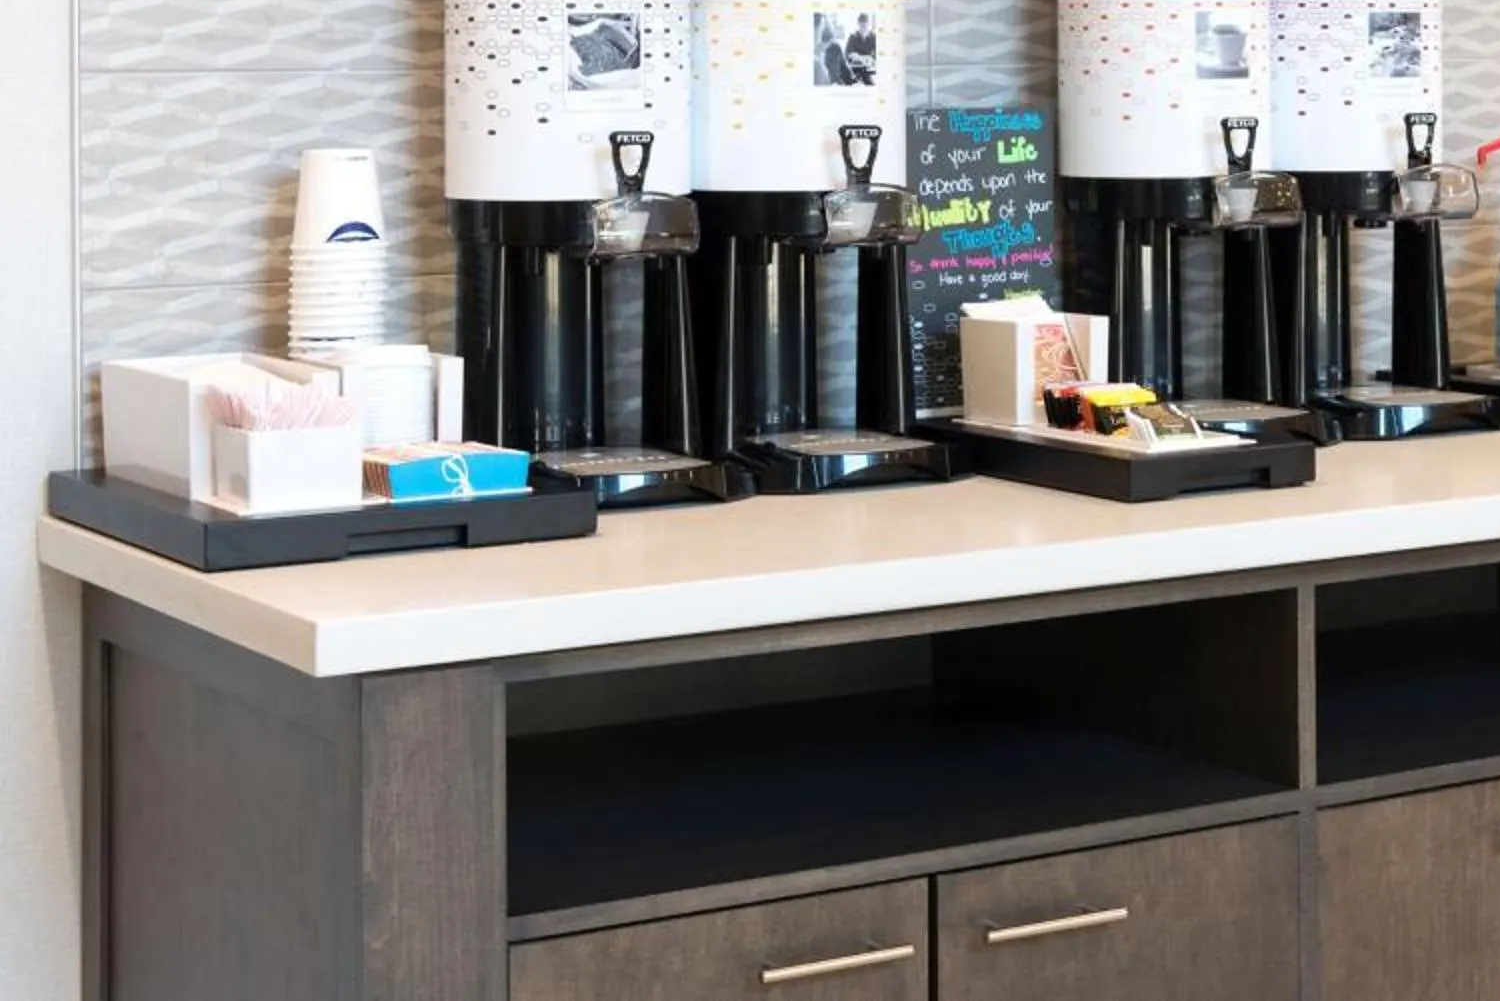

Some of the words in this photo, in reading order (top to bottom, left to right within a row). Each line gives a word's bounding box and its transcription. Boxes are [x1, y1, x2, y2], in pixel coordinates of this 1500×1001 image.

[912, 111, 941, 132] The
[616, 134, 651, 143] FETCO
[844, 128, 879, 137] FETCO
[920, 143, 936, 164] of
[947, 146, 987, 170] your
[997, 135, 1039, 164] Life
[919, 172, 974, 199] depends
[982, 173, 1018, 196] upon
[1023, 169, 1047, 185] the
[999, 199, 1016, 219] of
[1025, 199, 1053, 220] your
[939, 270, 964, 287] Have
[981, 270, 1007, 288] good
